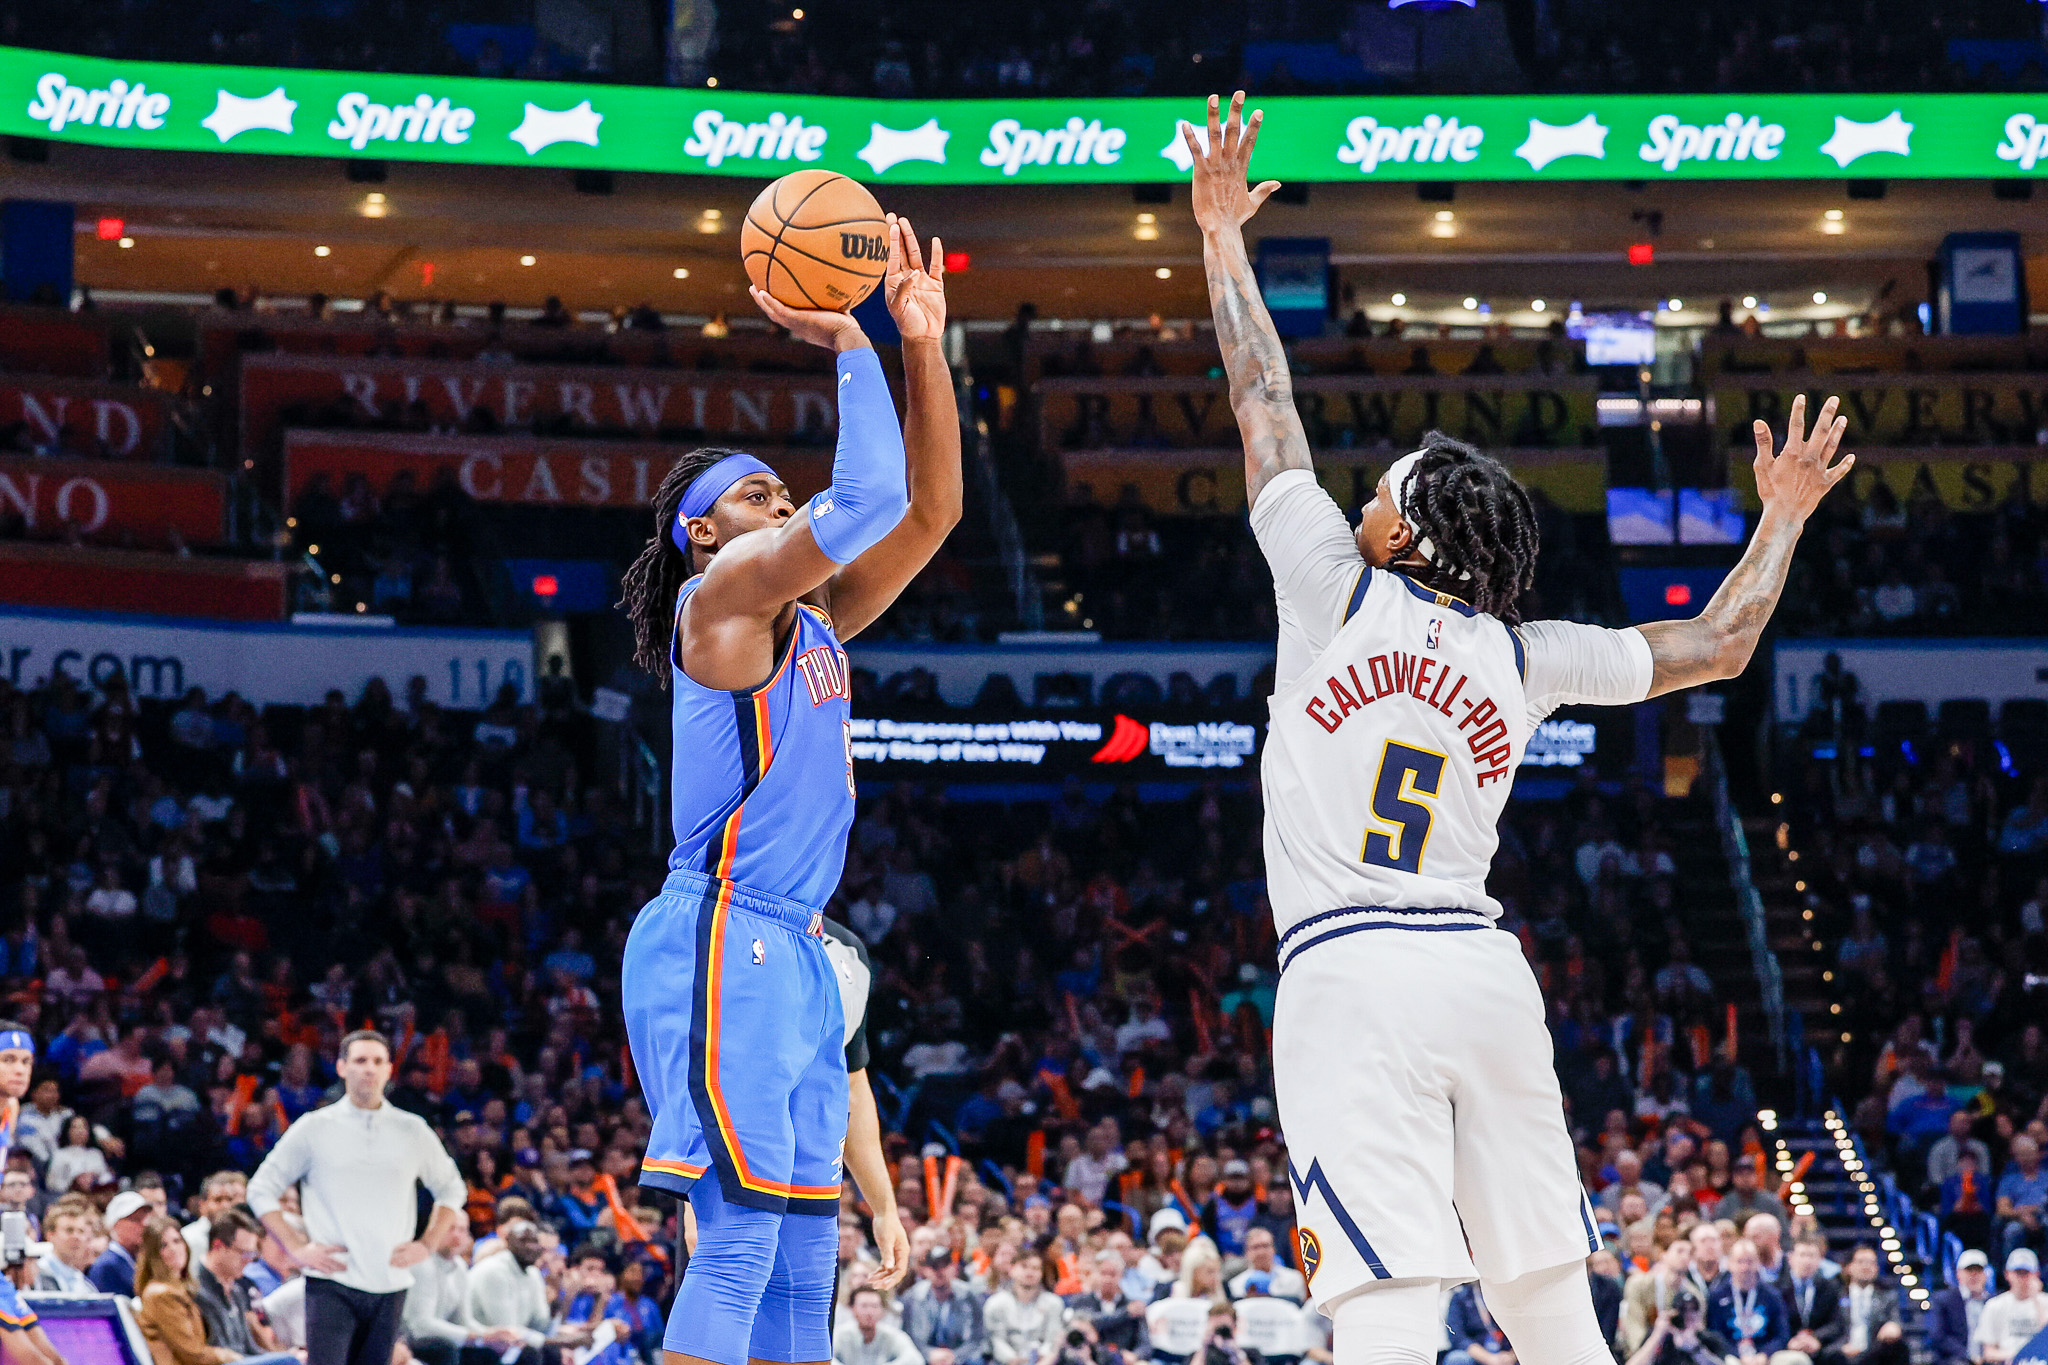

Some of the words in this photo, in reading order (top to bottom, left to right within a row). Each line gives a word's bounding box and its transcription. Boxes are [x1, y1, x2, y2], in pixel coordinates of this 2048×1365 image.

[28, 74, 170, 131] Sprite
[328, 93, 475, 149] Sprite
[684, 110, 828, 167] Sprite
[981, 117, 1126, 175] Sprite
[1338, 115, 1483, 172] Sprite
[1640, 113, 1785, 171] Sprite
[1077, 391, 1568, 445] RIVRWIND
[1304, 650, 1512, 789] CALDWELL-POPE
[1359, 738, 1449, 874] 5
